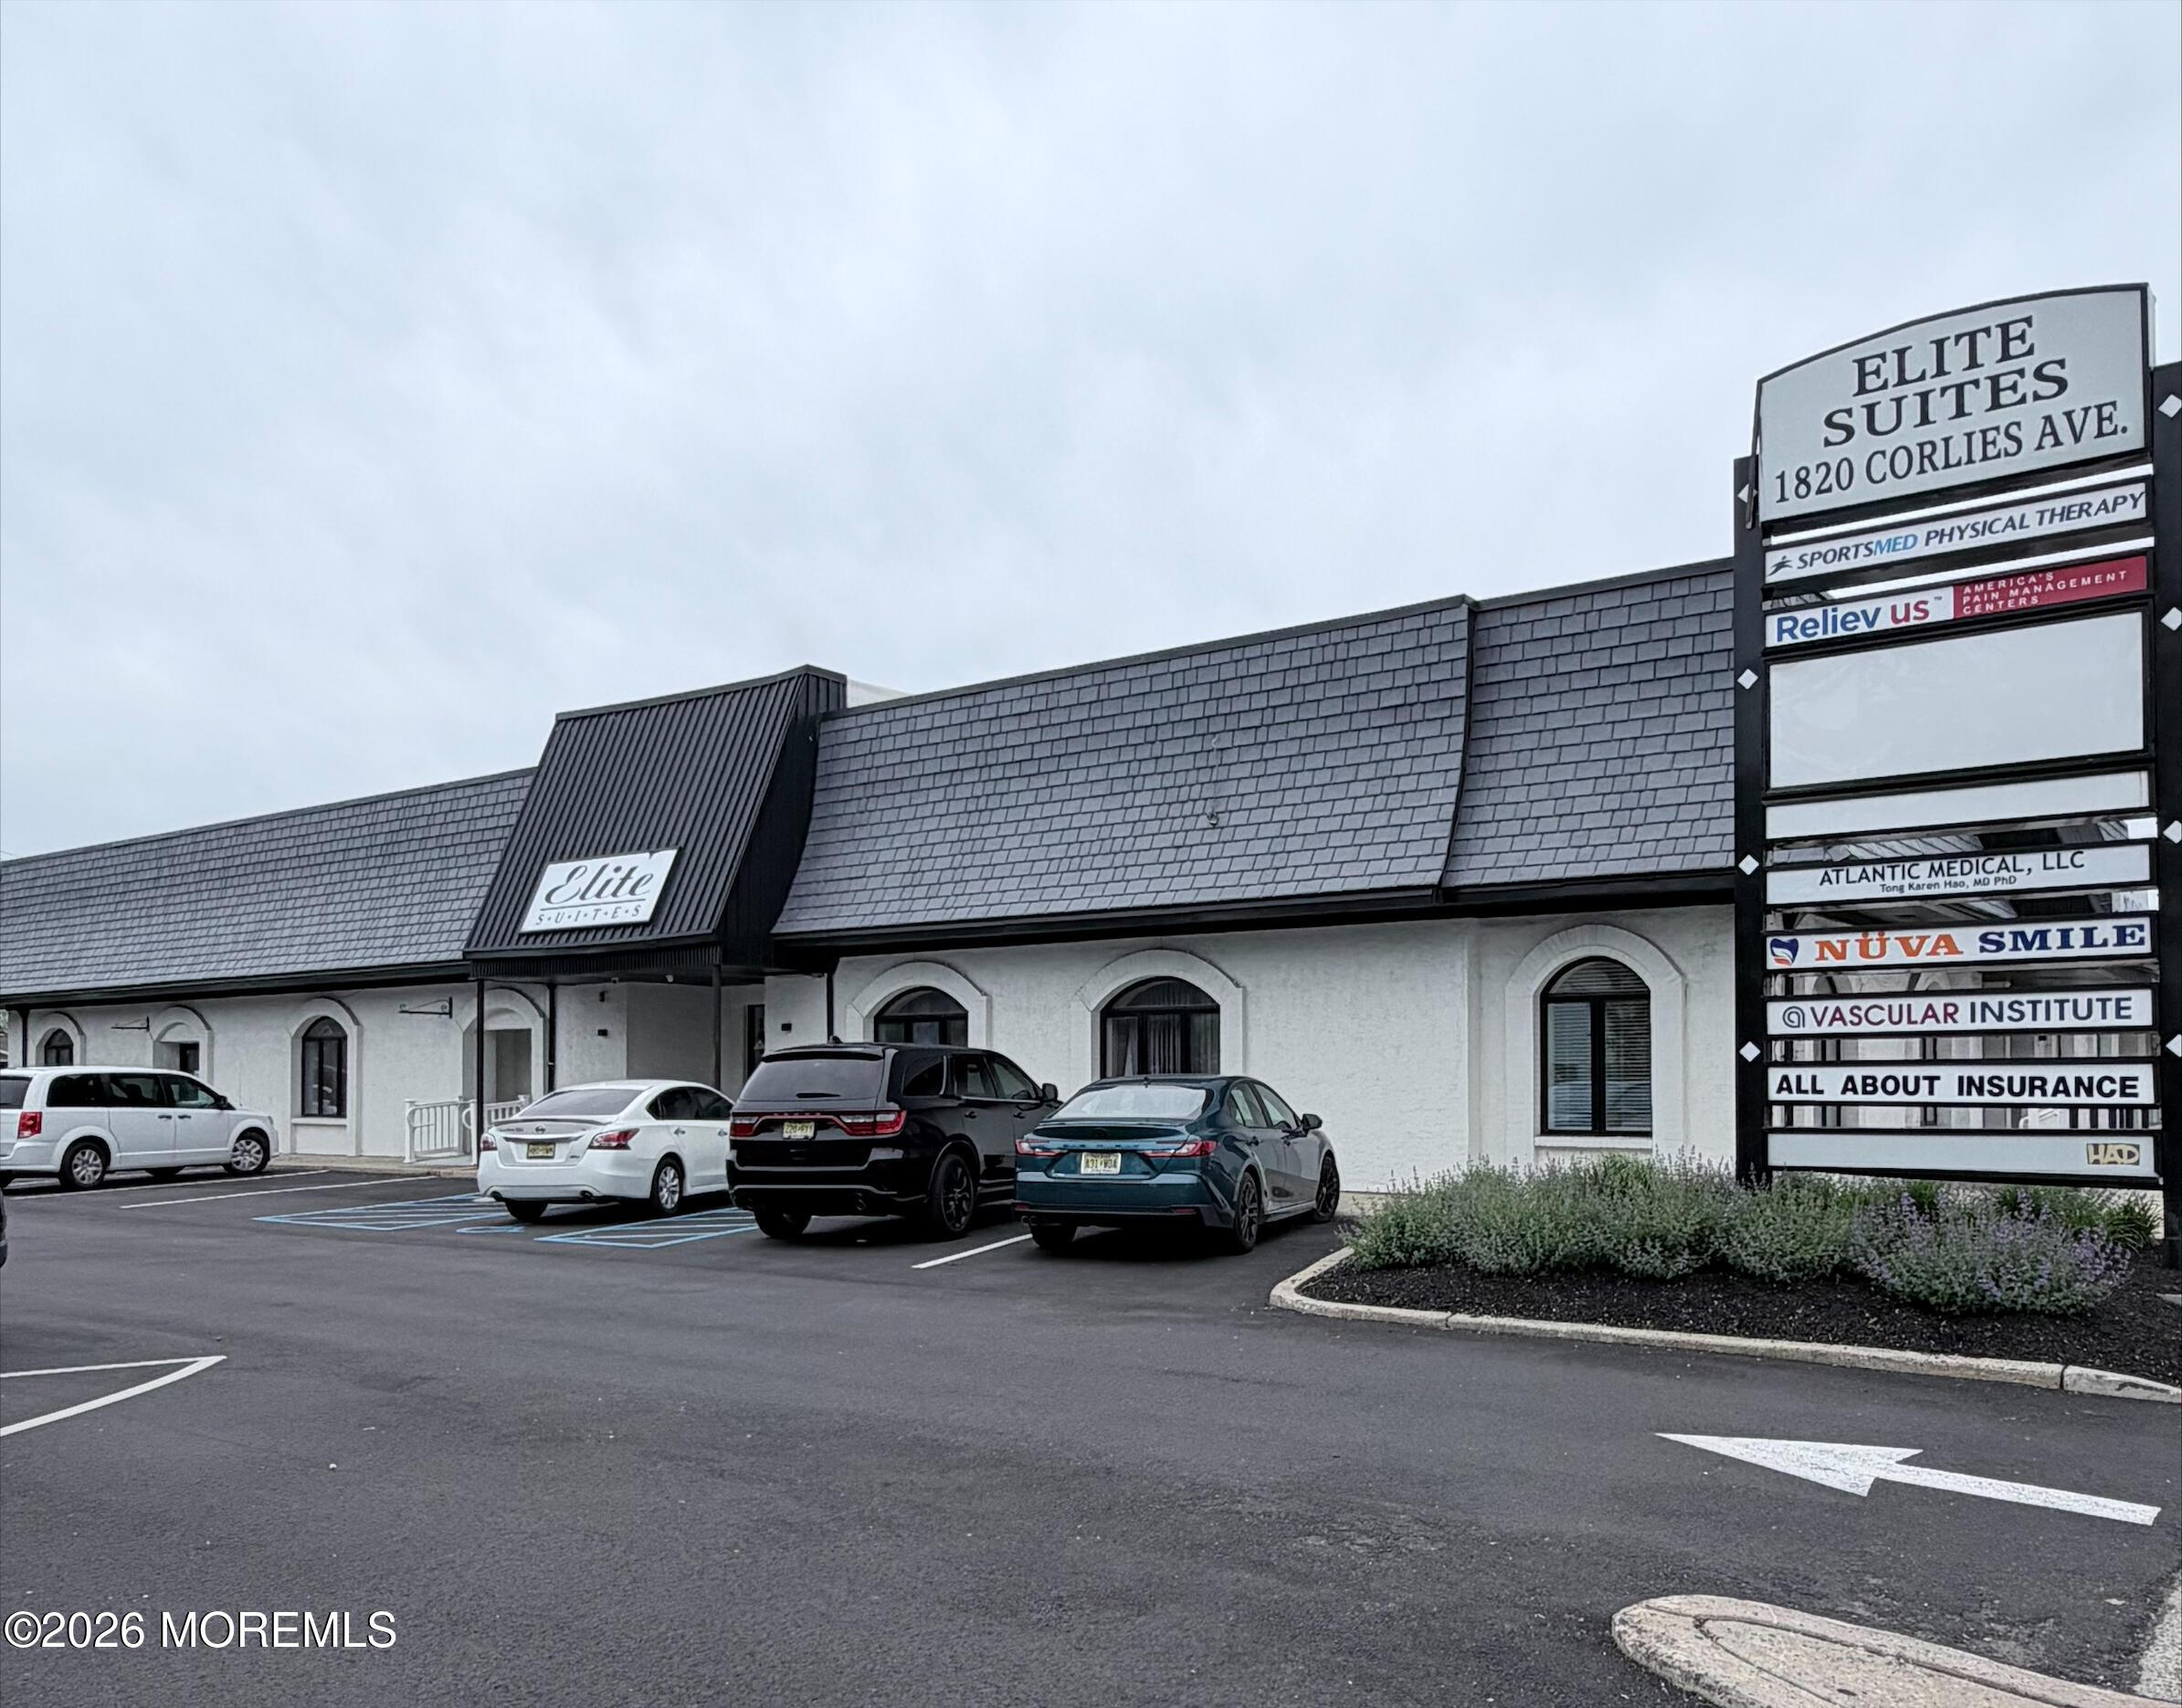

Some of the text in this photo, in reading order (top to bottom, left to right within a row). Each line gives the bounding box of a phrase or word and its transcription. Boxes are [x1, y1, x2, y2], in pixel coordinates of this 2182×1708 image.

[1852, 315, 2035, 397] ELITE
[1823, 358, 2069, 448] SUITES
[1776, 400, 2128, 503] 1820 CORLIES AVE.
[1797, 490, 2145, 570] SPORTSMED PHYSICAL THERAPY
[1963, 572, 2054, 595] AMERICA'S
[1963, 570, 2127, 606] PAIN MANAGEMENT
[1963, 596, 2039, 615] CENTERS
[1776, 606, 1882, 642] Reliev
[544, 863, 654, 905] Elite
[1819, 850, 2085, 886] ATLANTIC MEDICAL, LLC
[1880, 875, 2017, 894] Tong Karen Hao, MD PhD
[1814, 924, 2146, 962] NÜVA SMILE
[1969, 996, 2133, 1024] INSTITUTE
[1776, 1074, 2140, 1099] ALL ABOUT INSURANCE
